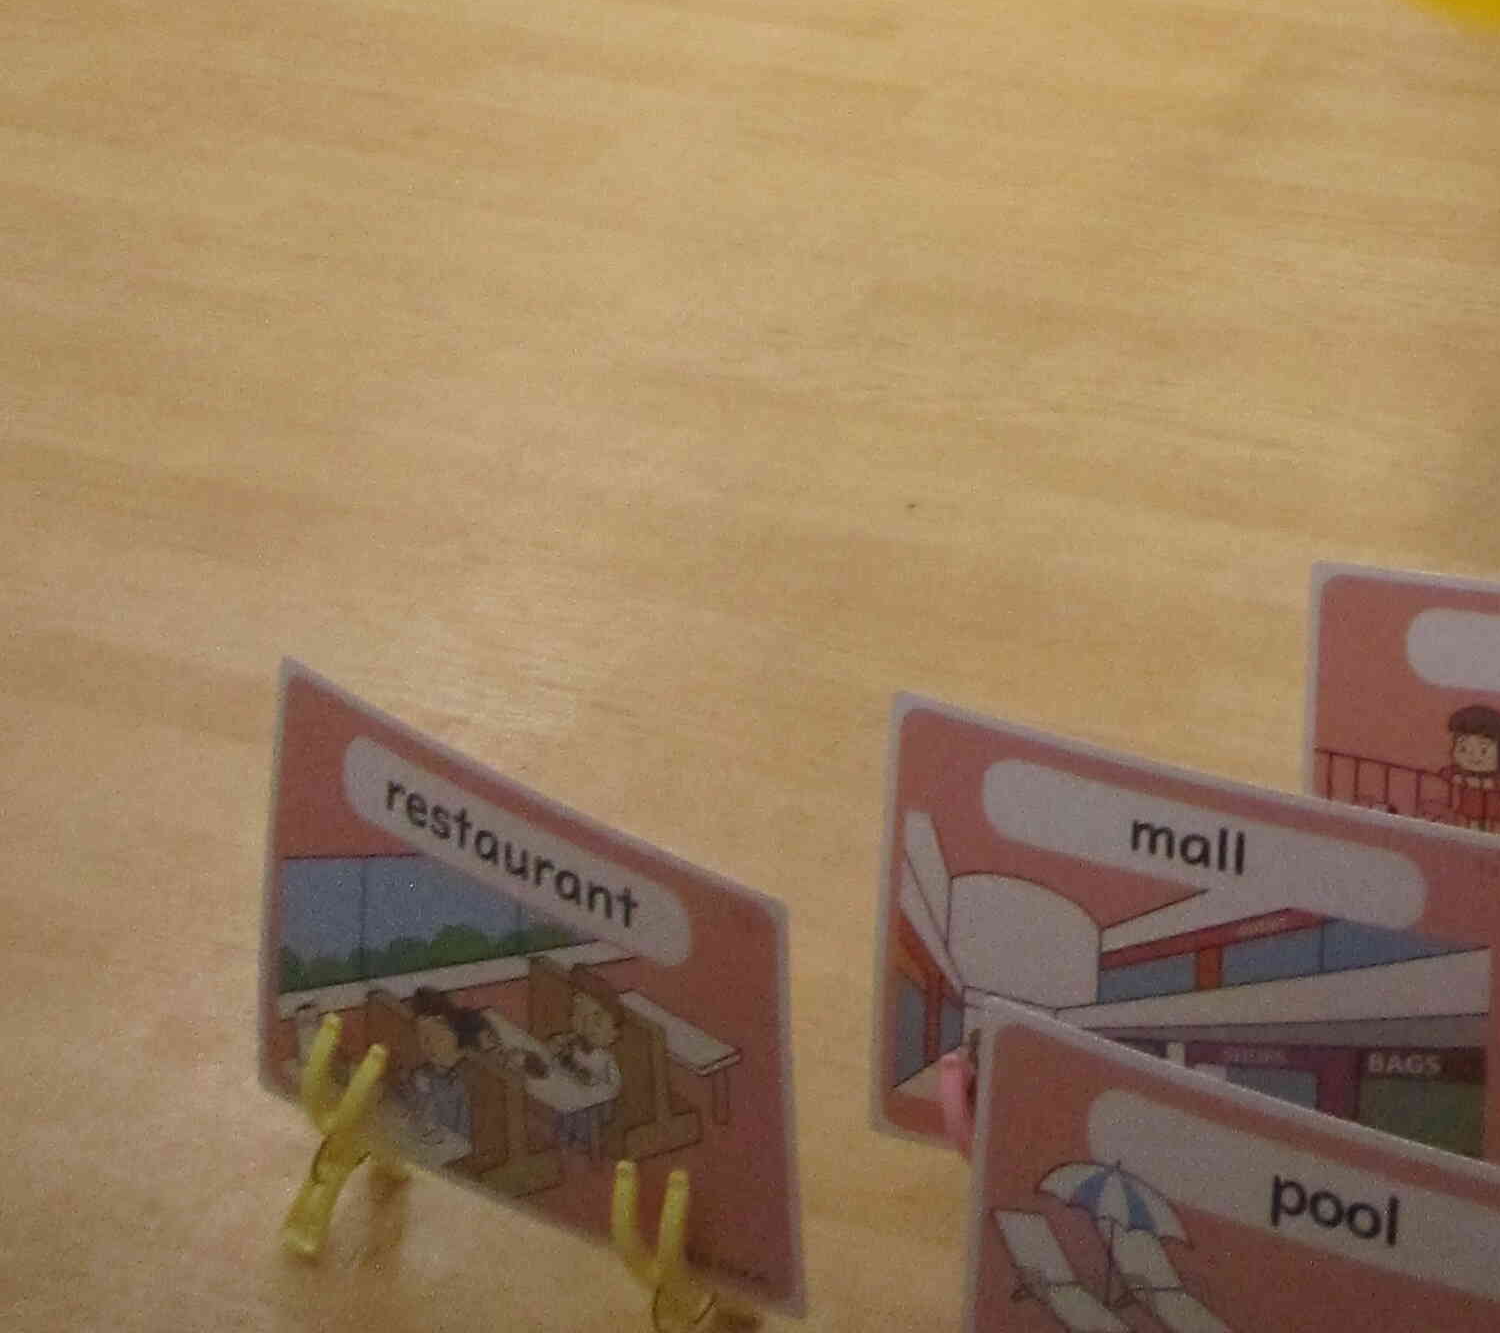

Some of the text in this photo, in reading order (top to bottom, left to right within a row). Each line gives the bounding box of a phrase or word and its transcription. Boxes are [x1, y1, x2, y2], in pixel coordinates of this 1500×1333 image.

[384, 779, 640, 929] restaurant
[1130, 817, 1247, 876] mall
[1367, 1051, 1442, 1076] BAGS
[1270, 1172, 1400, 1246] pool
